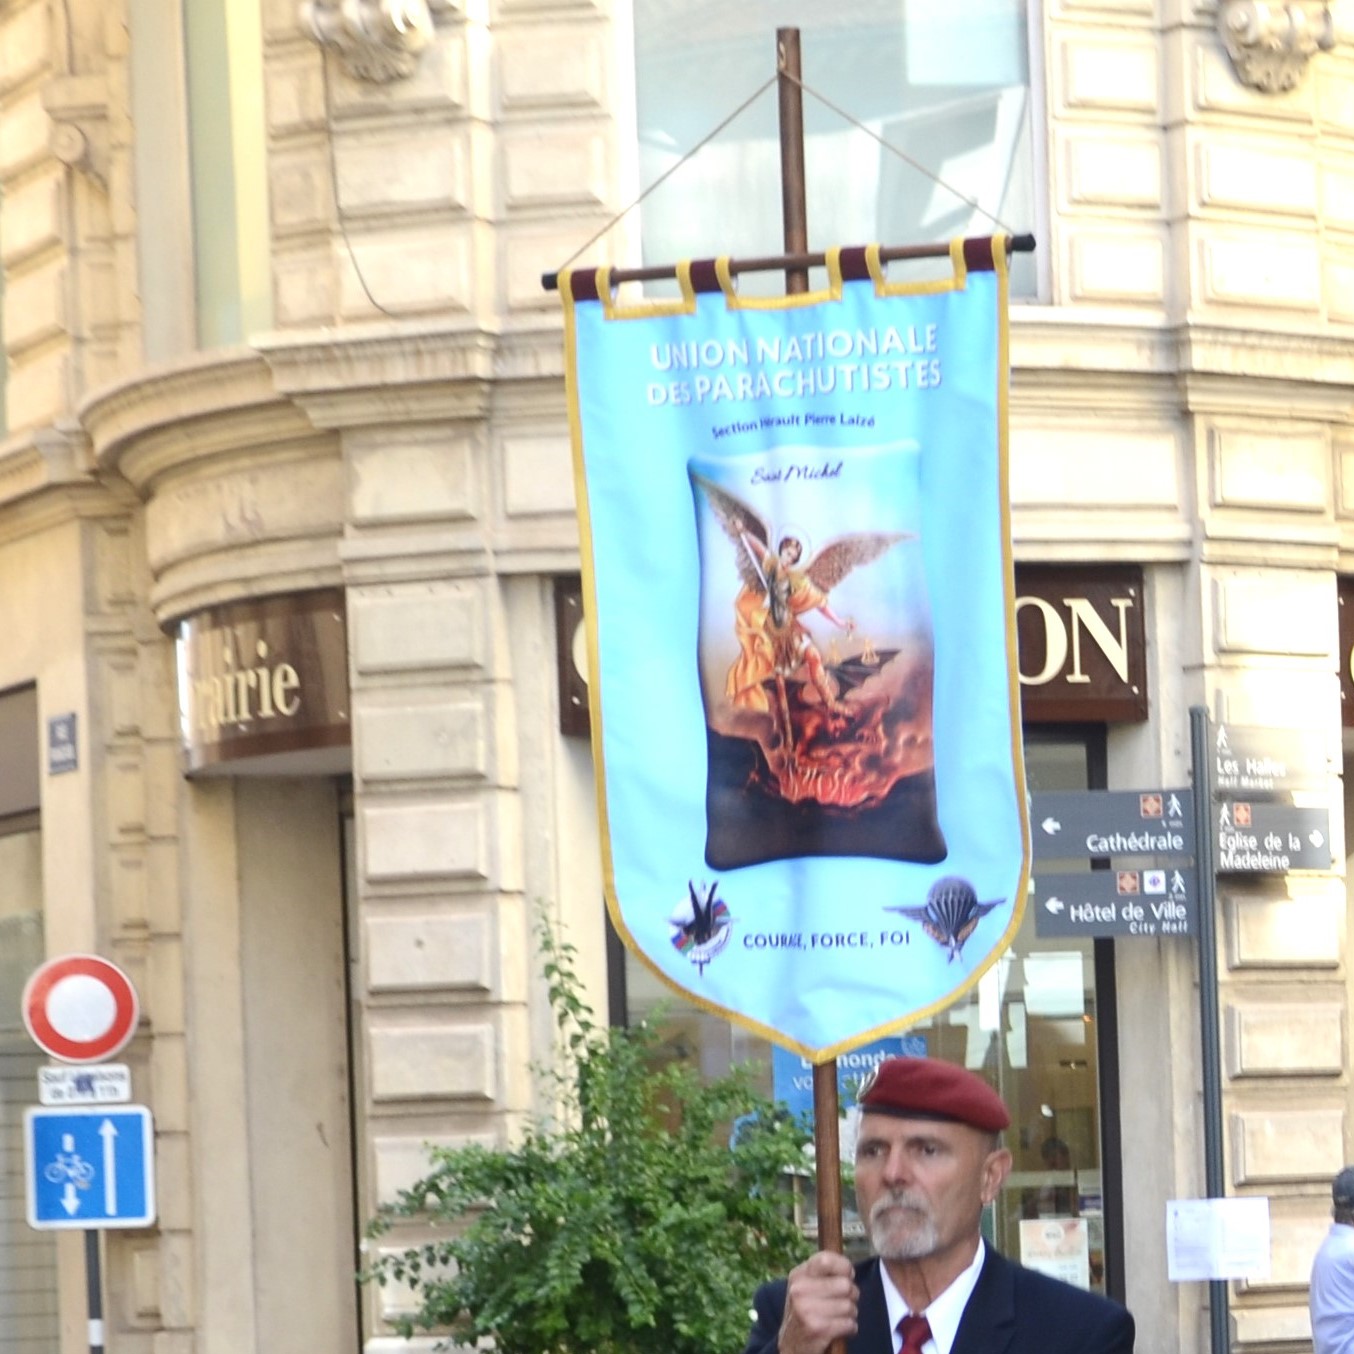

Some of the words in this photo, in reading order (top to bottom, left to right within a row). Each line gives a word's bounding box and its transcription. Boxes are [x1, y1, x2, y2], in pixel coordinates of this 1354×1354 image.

[651, 337, 748, 372] UNION
[756, 323, 938, 366] NATIONALE
[647, 379, 691, 406] DES
[693, 359, 942, 402] PARACHUTISTES
[1216, 757, 1239, 774] Les
[1086, 831, 1184, 853] Cathédrale
[1264, 831, 1283, 852] de
[1288, 832, 1302, 852] la
[1219, 851, 1291, 871] Madeleine
[1070, 902, 1117, 923] Hôtel
[1121, 901, 1145, 922] de
[1150, 900, 1187, 921] Ville
[1129, 920, 1156, 936] City
[1162, 920, 1188, 934] Hall
[811, 932, 874, 949] FORCE,
[880, 930, 910, 946] FOI
